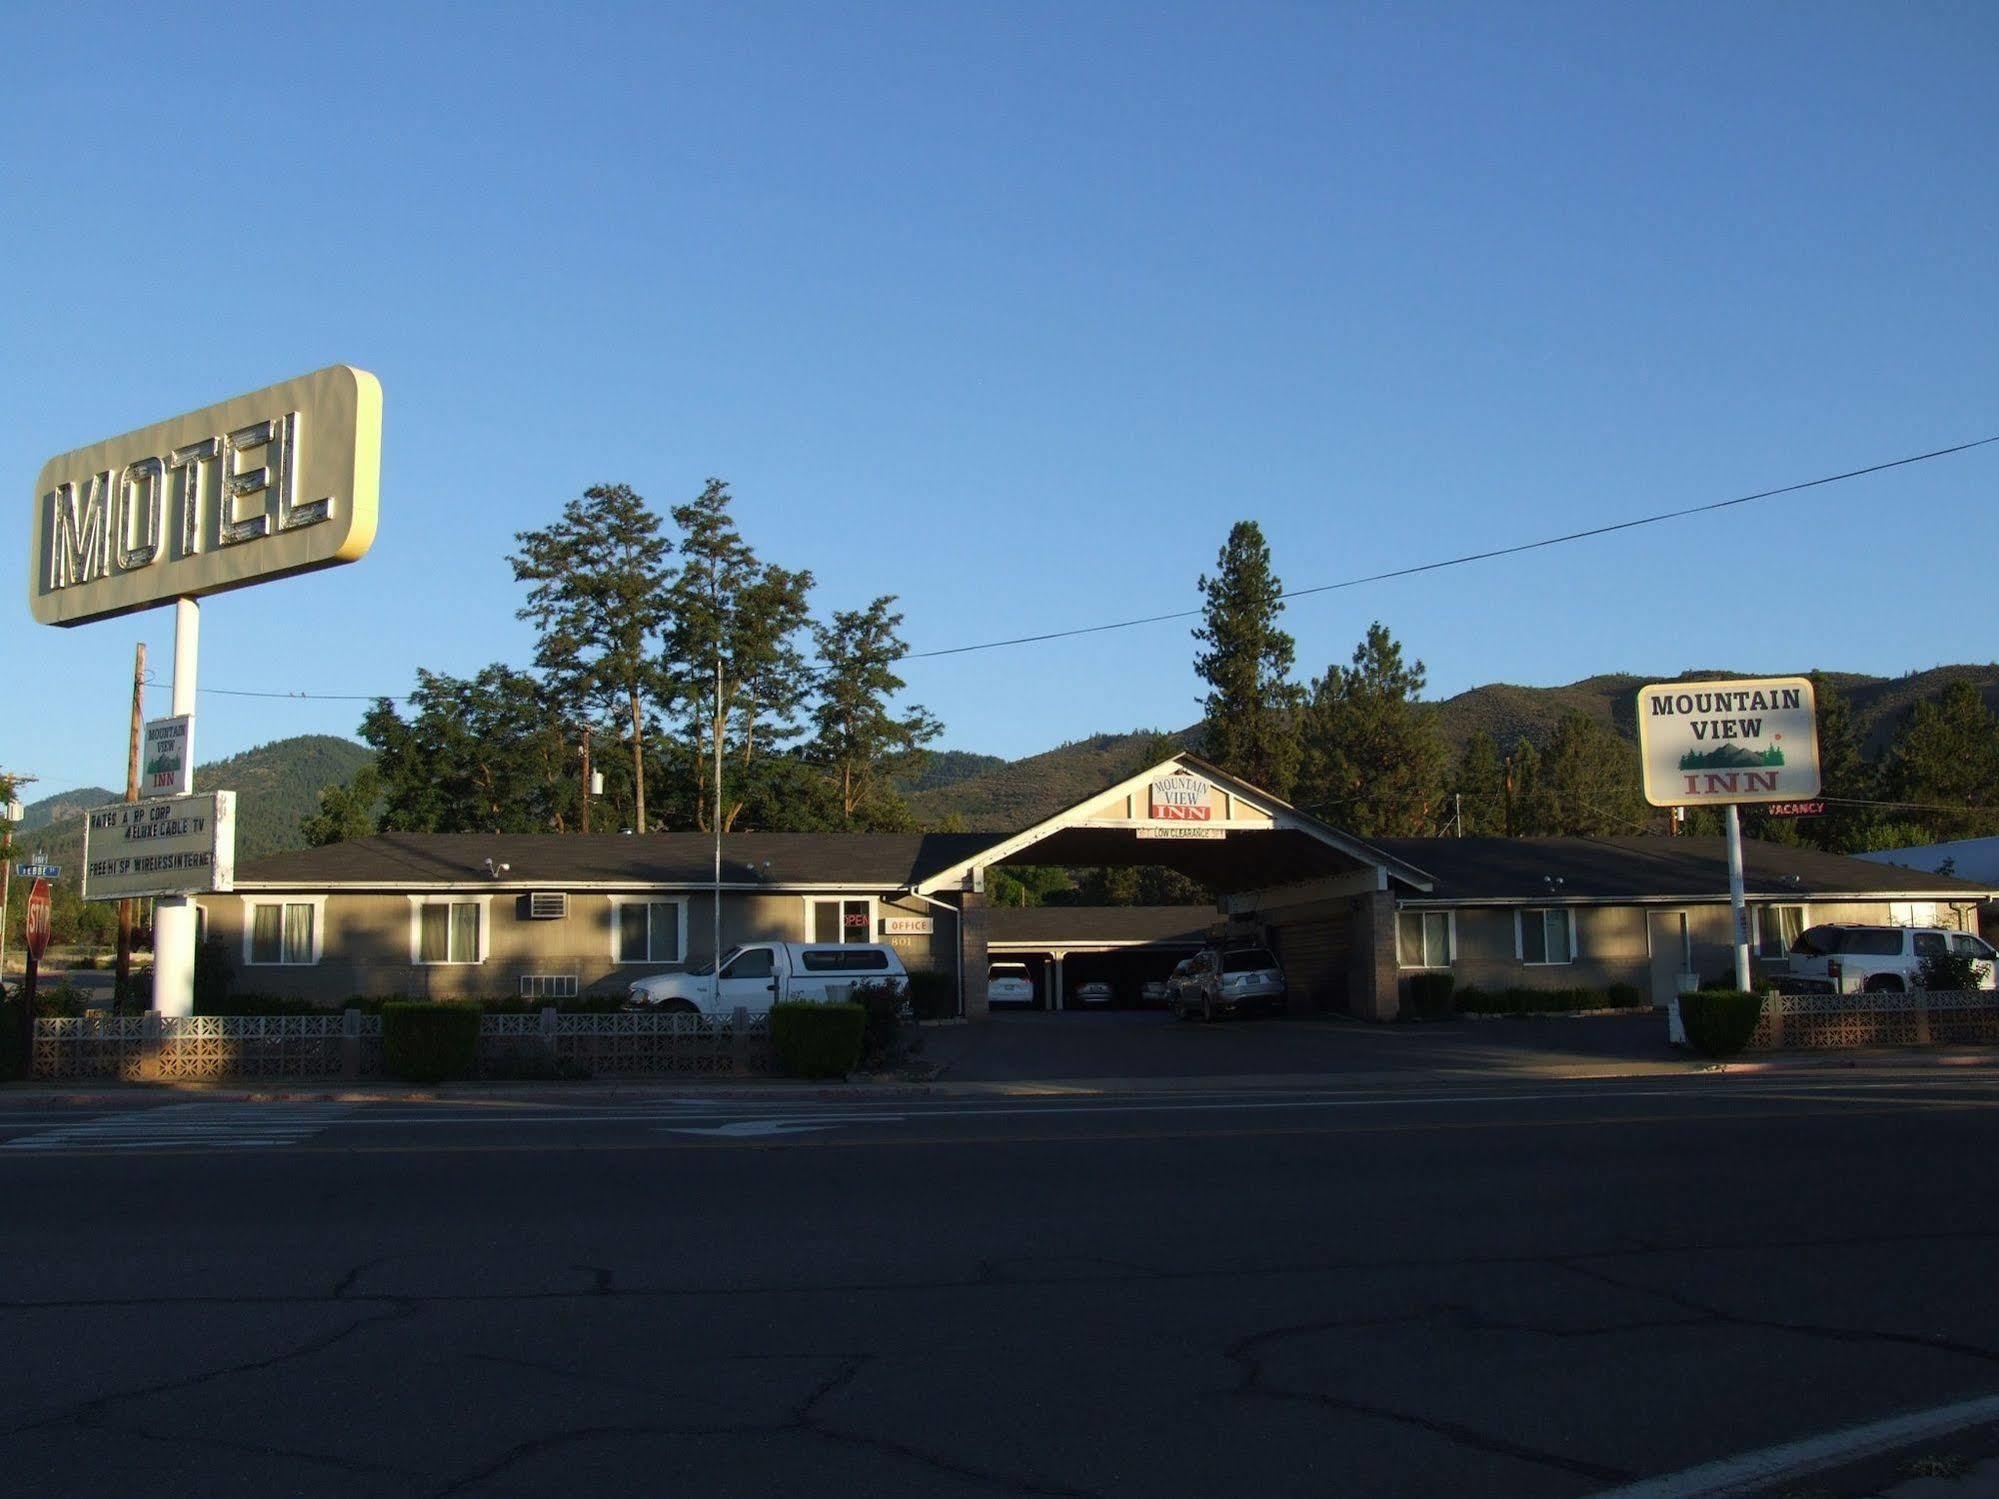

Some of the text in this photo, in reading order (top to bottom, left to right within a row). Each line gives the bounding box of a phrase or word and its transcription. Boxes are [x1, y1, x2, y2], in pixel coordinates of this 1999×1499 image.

[51, 411, 335, 590] MOTEL
[1651, 689, 1800, 716] MOUNTAIN
[148, 725, 187, 741] MOUNTAIN
[1690, 719, 1762, 740] VIEW
[157, 740, 176, 753] VIEW
[154, 772, 175, 788] INN
[1155, 778, 1209, 795] MOUNTAIN
[1684, 771, 1780, 795] INN
[1165, 791, 1199, 805] VIEW
[91, 811, 117, 829] RATES
[150, 806, 171, 821] CORP
[1157, 806, 1206, 820] INN
[1768, 803, 1825, 816] VACANCY
[160, 820, 187, 836] CABLE
[193, 818, 205, 833] TV
[1154, 828, 1170, 838] LOW
[1171, 829, 1209, 838] CLEARANCE
[119, 860, 130, 874] SP
[29, 903, 50, 934] STOP
[845, 914, 870, 927] OPEN
[892, 921, 927, 930] OFFICE
[891, 937, 912, 947] 801
